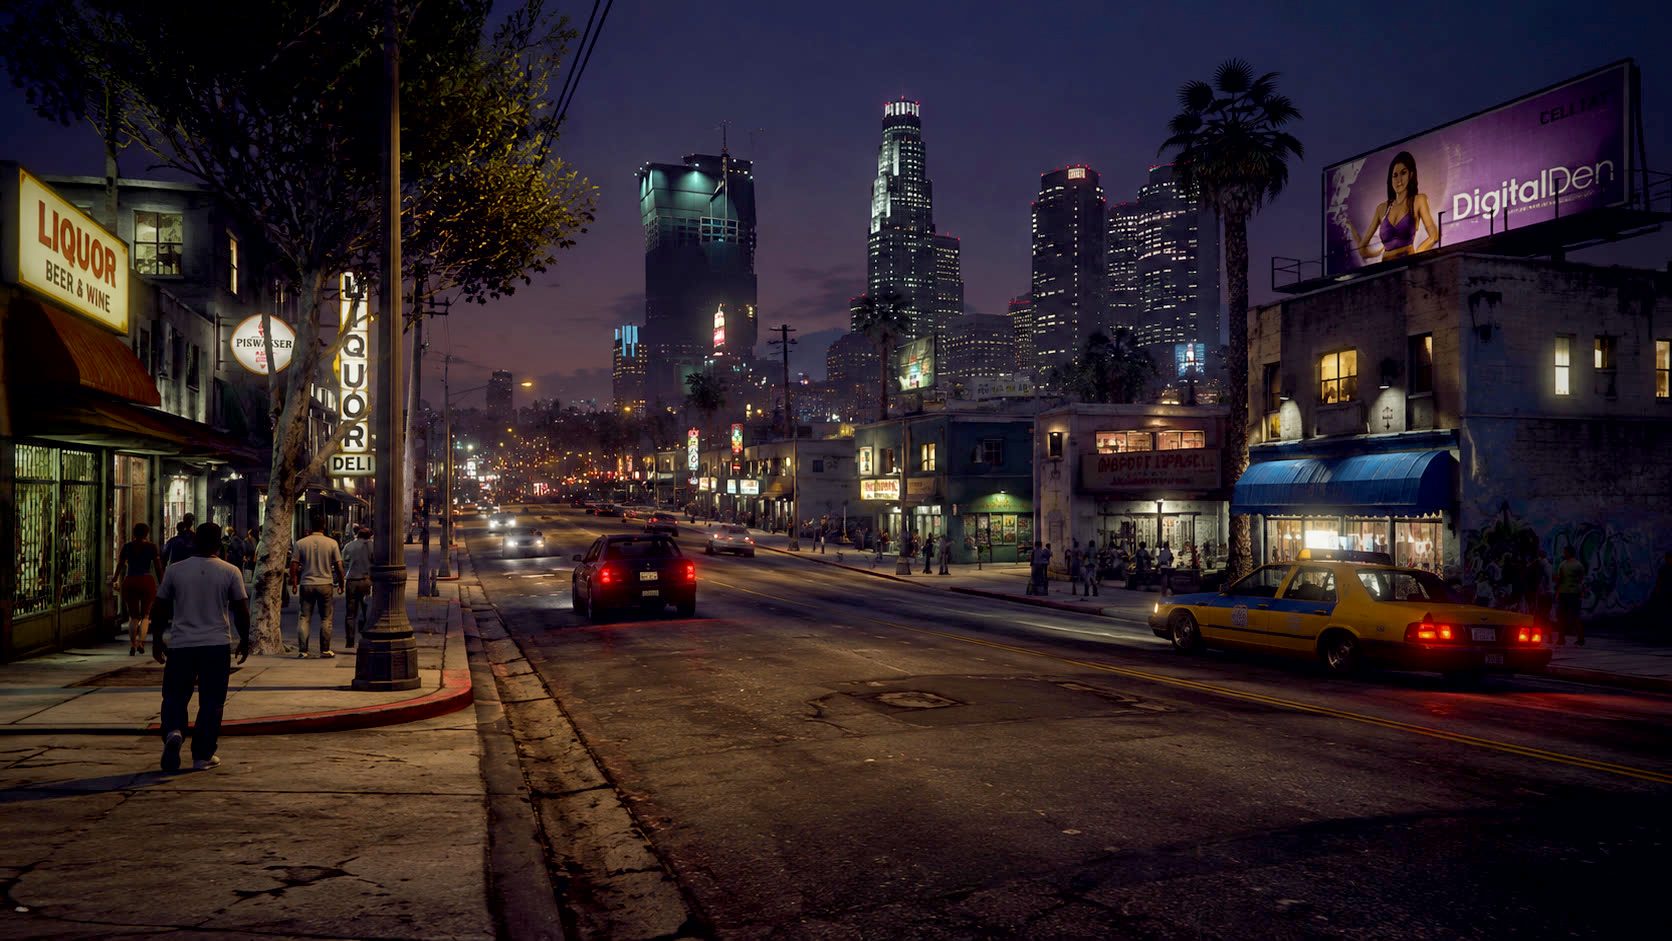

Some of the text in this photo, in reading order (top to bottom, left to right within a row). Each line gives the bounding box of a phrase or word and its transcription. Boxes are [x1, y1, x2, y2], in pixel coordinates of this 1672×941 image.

[1453, 160, 1614, 219] DigitalDen
[38, 199, 117, 289] LIQUOR
[46, 259, 112, 313] BEER & WINE
[333, 456, 373, 472] DELI
